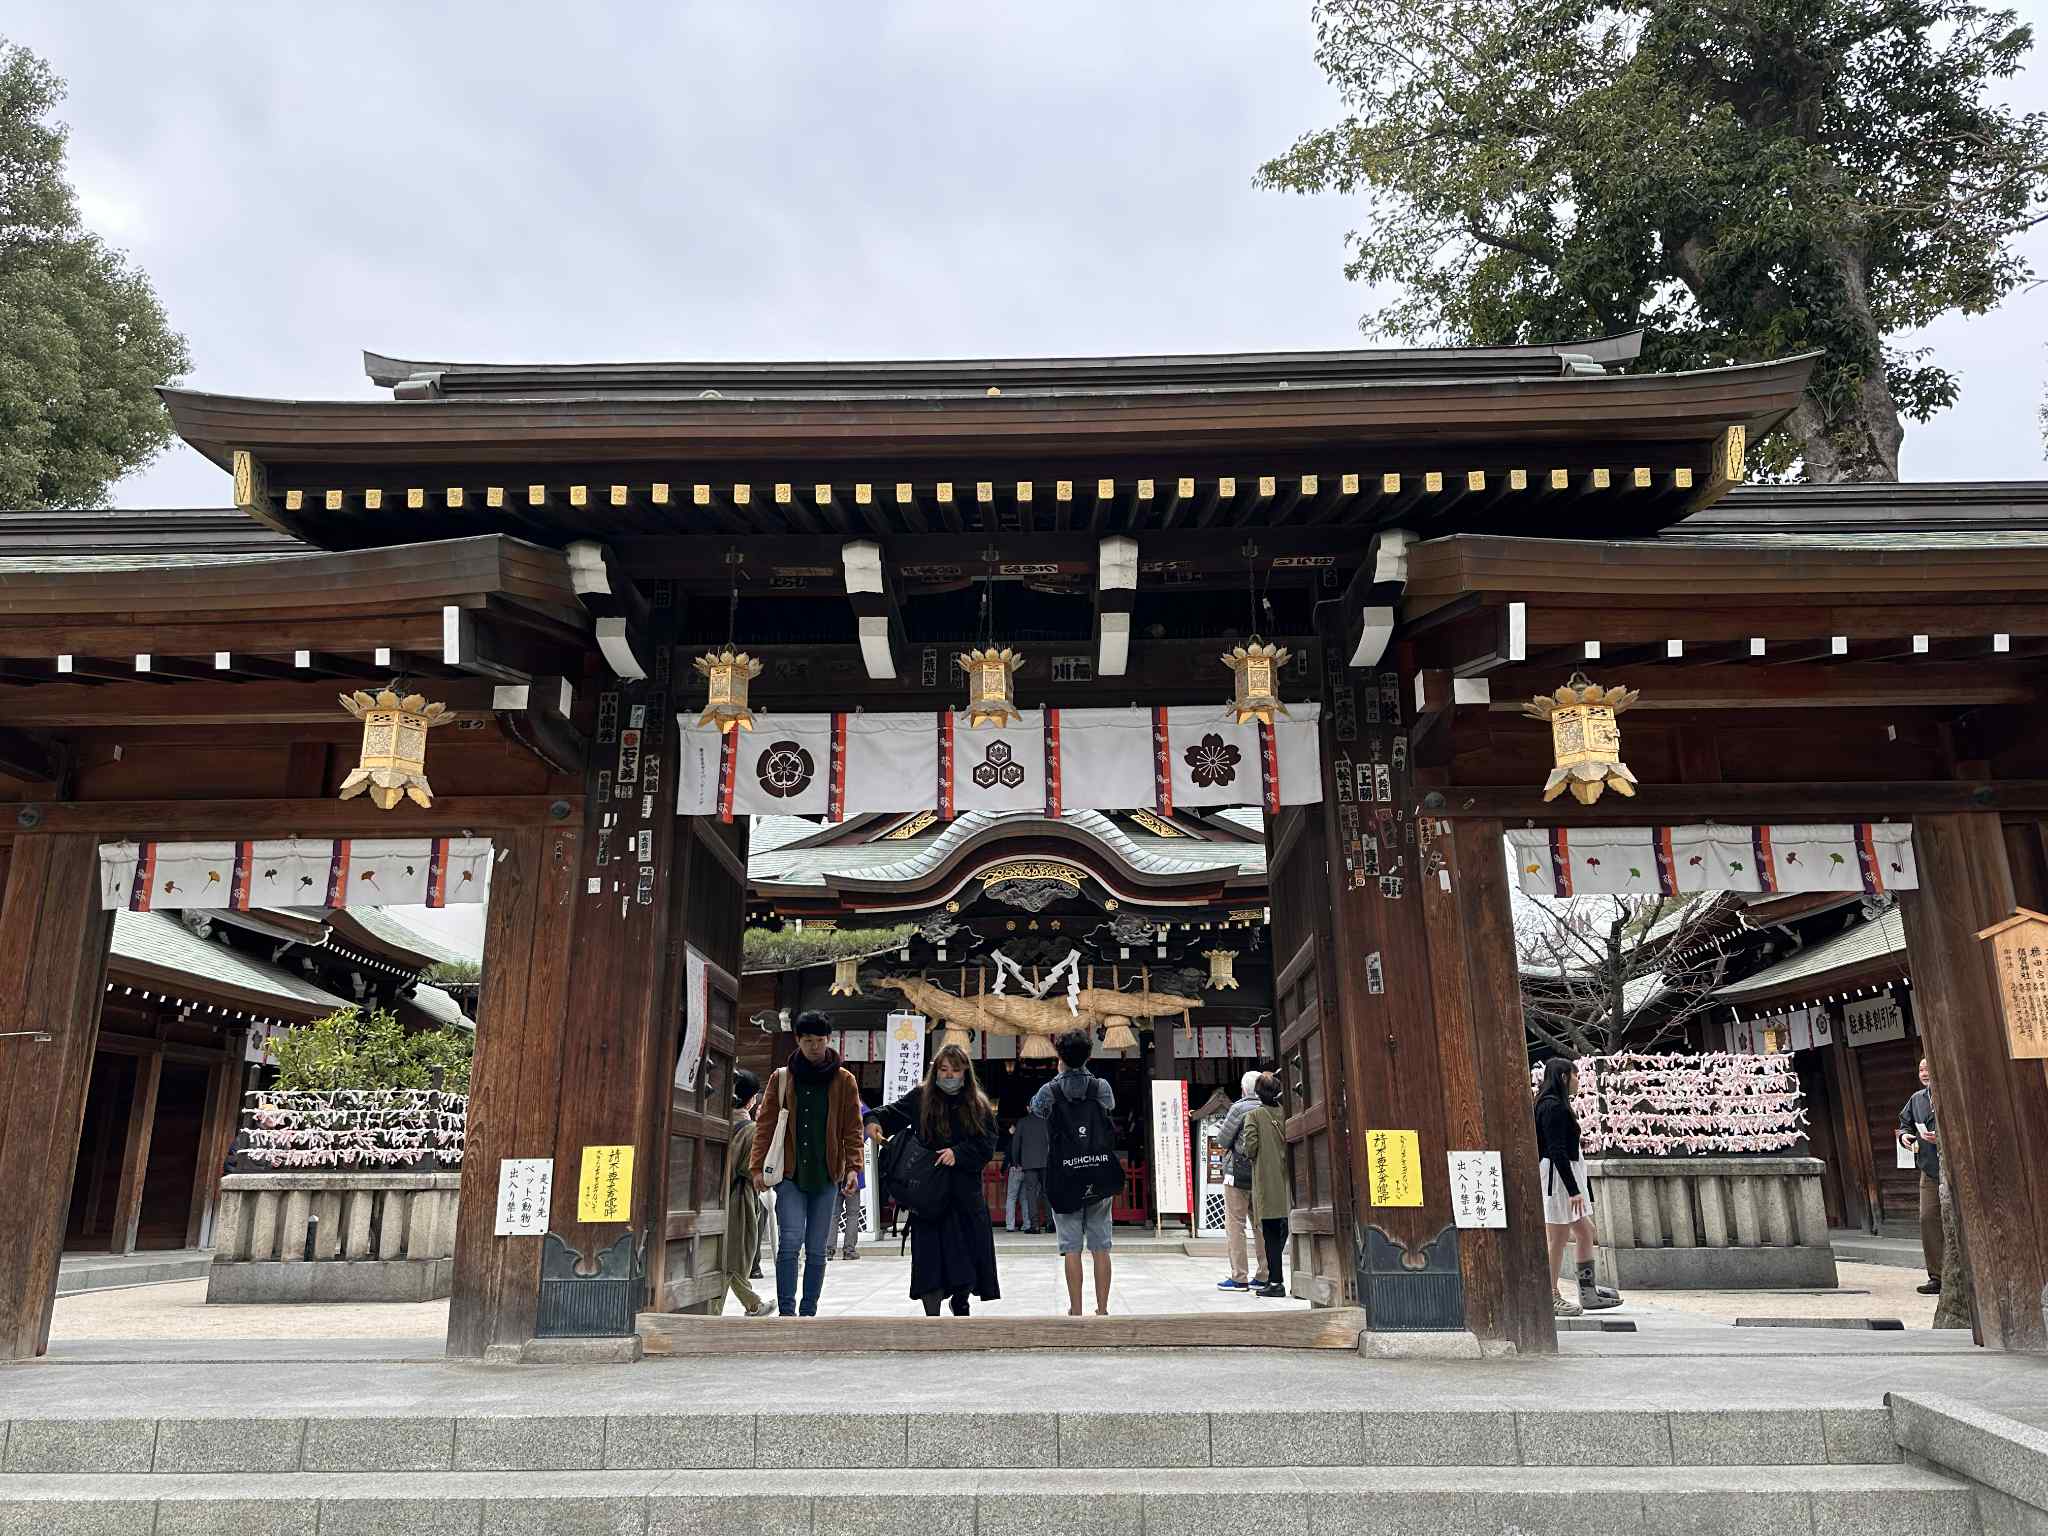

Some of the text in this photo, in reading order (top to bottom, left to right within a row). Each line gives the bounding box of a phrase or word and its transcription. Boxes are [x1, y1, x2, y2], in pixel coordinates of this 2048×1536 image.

[1063, 1154, 1109, 1167] PUSHCHAIR
[506, 1168, 519, 1223] 出入り禁止
[536, 1173, 547, 1218] 是より先
[1457, 1160, 1472, 1216] 出入り禁止
[1488, 1166, 1504, 1212] 是より先
